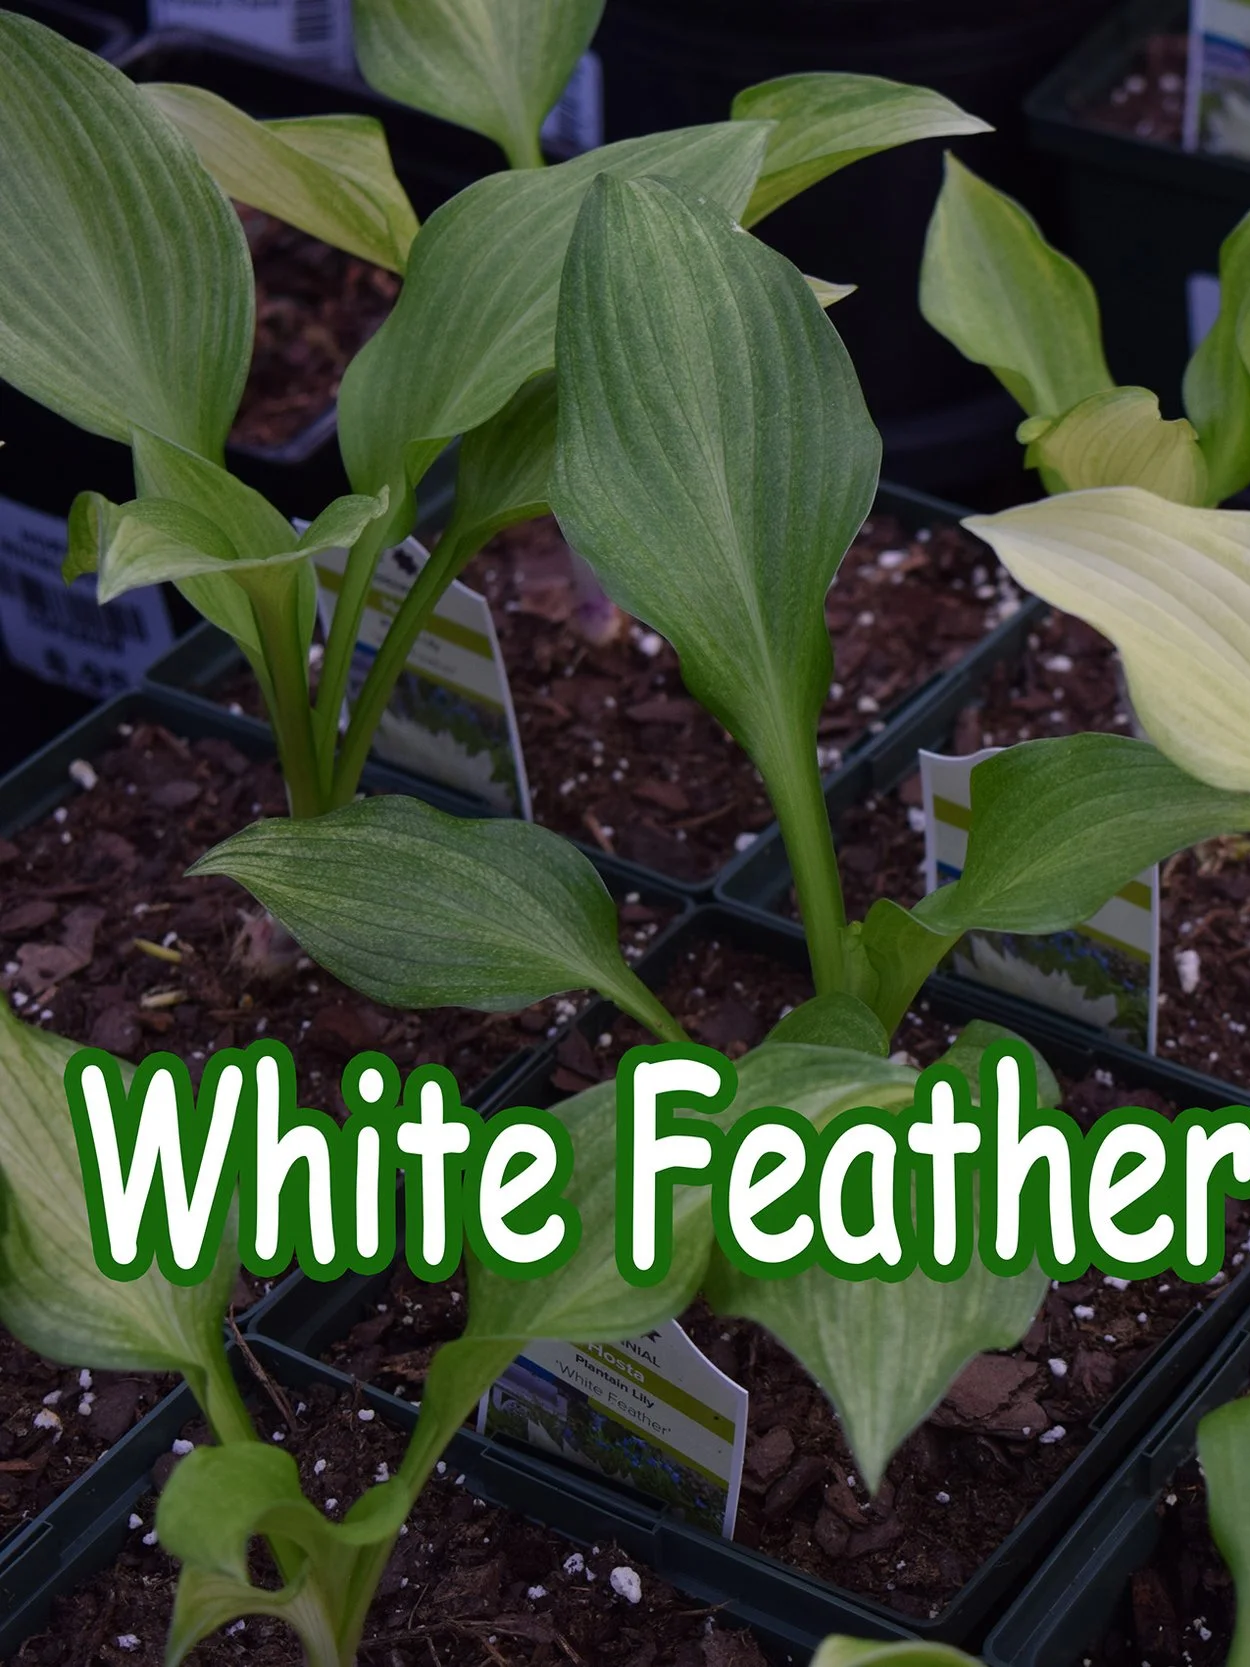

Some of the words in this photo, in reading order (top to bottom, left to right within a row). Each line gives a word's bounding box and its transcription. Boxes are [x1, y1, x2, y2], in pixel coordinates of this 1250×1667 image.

[574, 1353, 630, 1393] Plantain
[631, 1387, 656, 1410] Lily
[587, 1341, 646, 1384] Hosta
